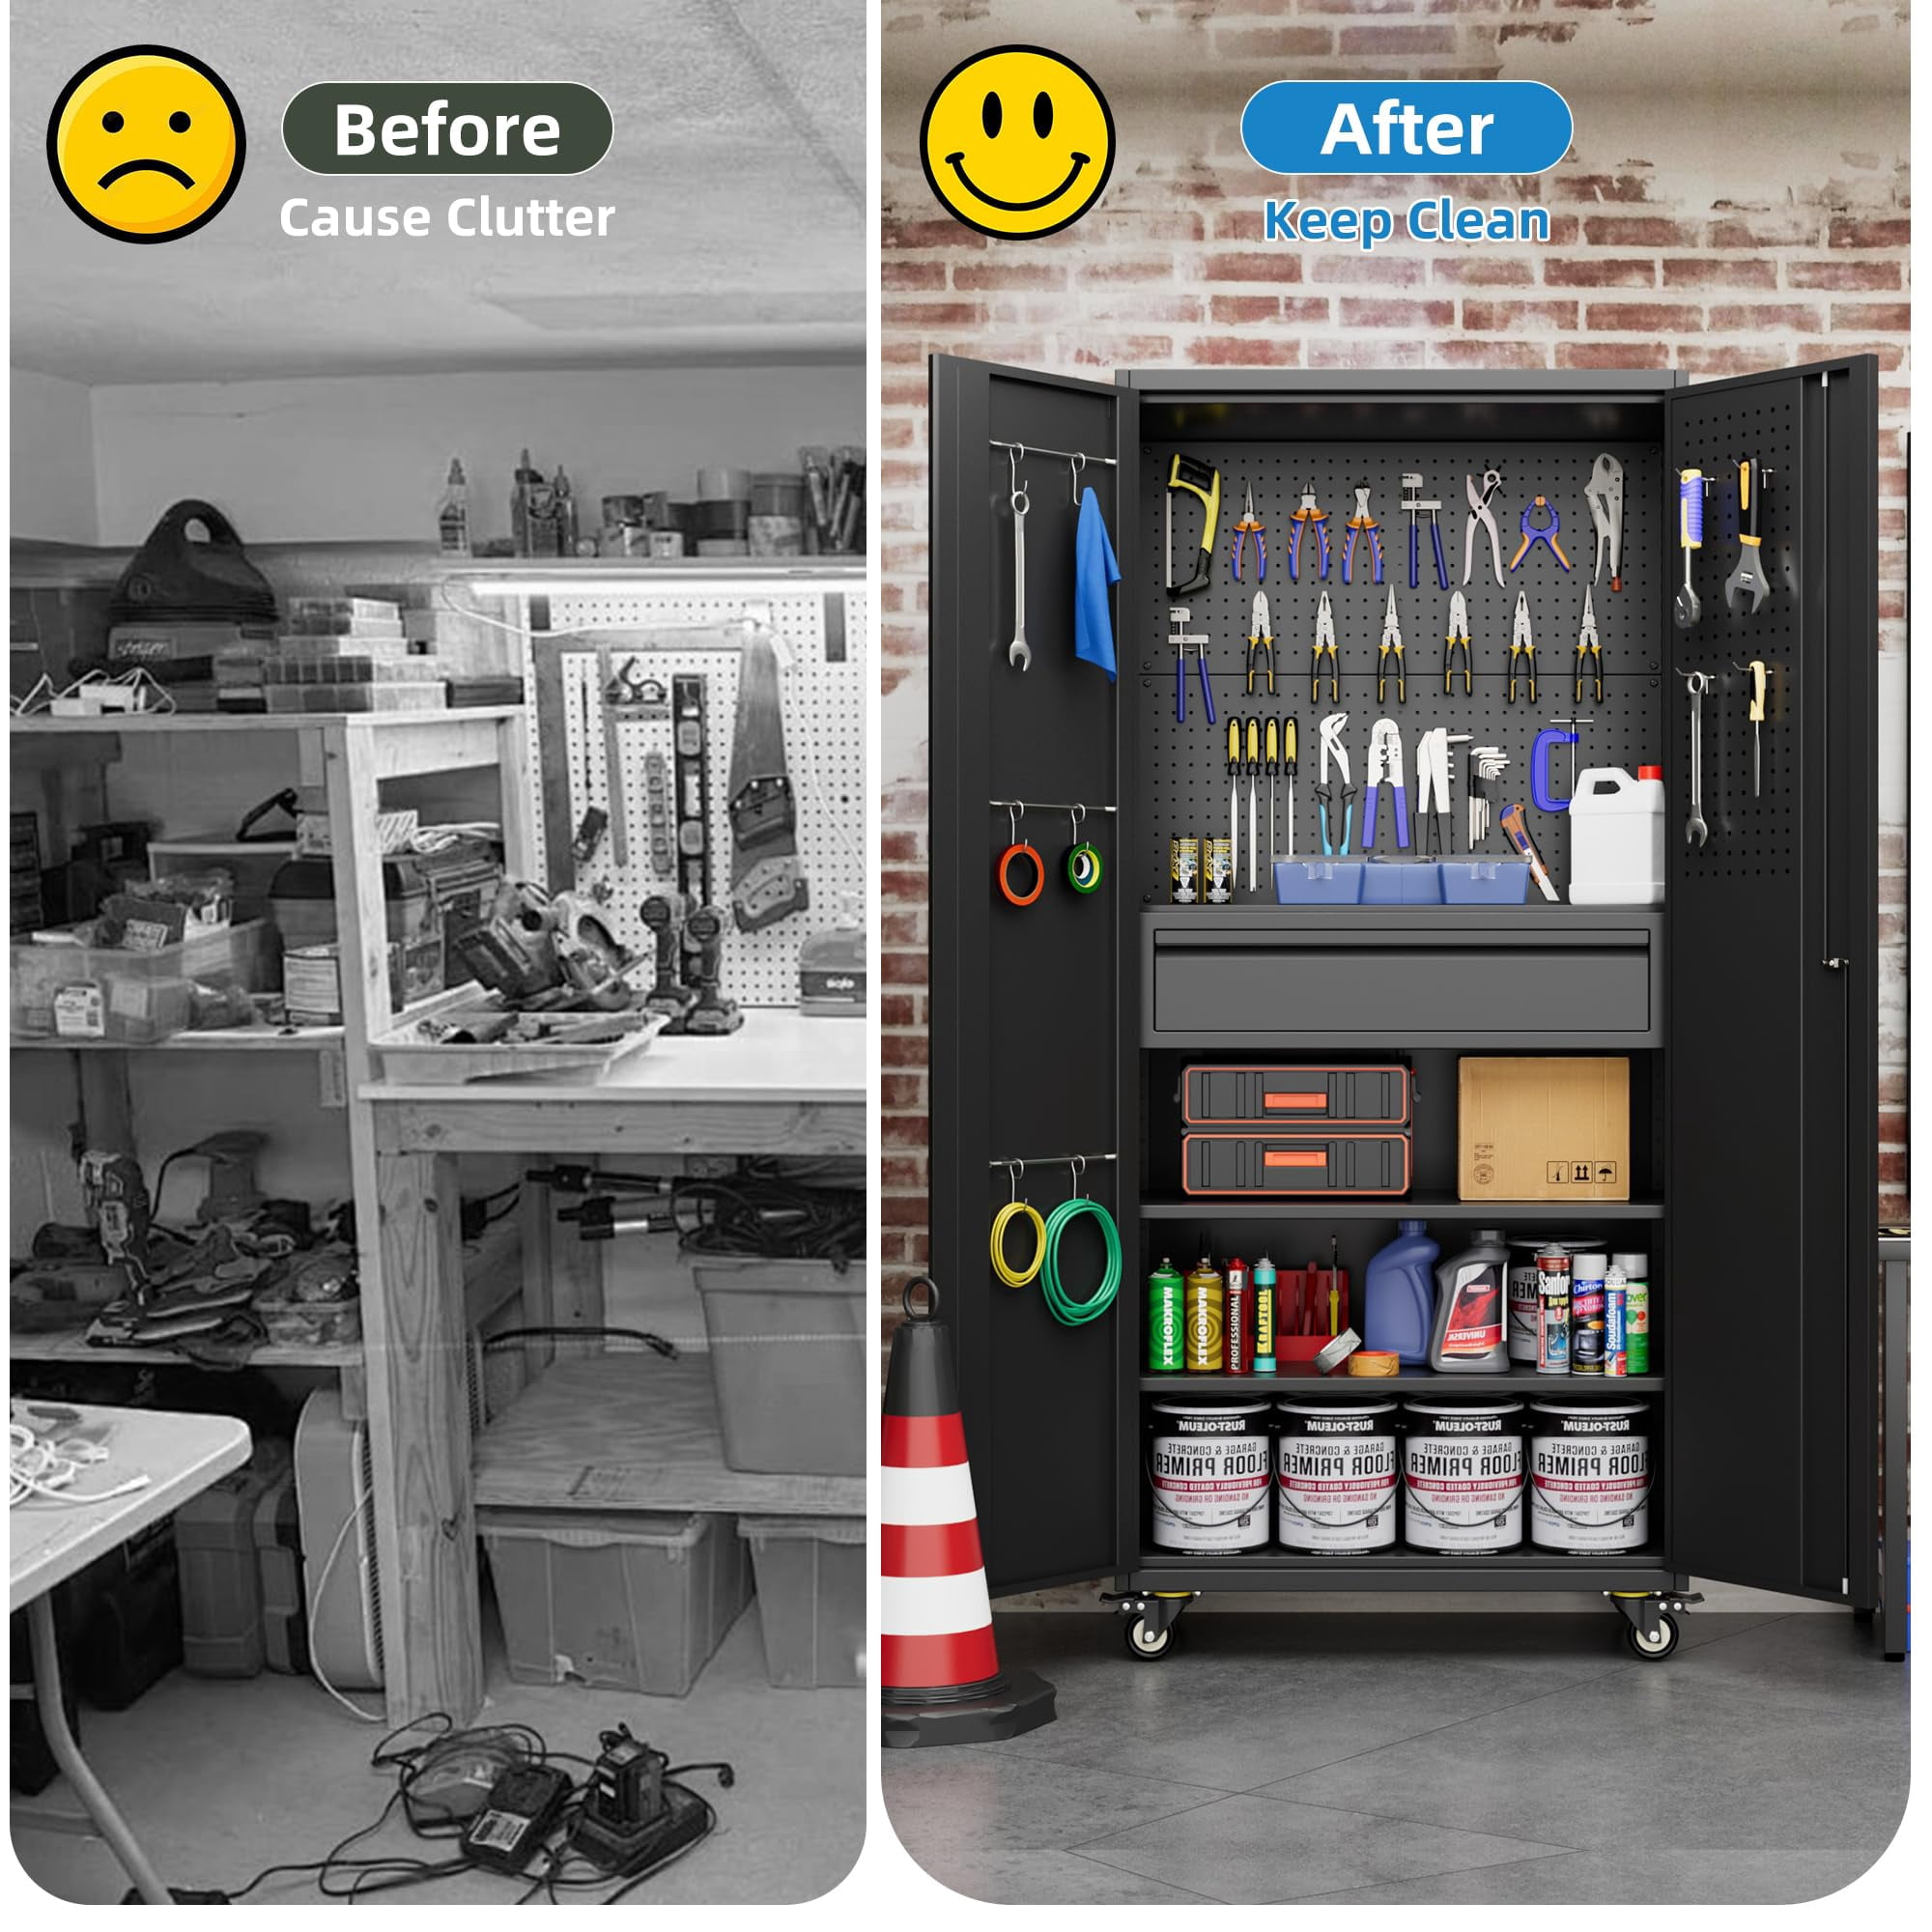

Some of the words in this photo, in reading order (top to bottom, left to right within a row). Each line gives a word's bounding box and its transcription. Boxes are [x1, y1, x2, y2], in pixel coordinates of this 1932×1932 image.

[1538, 1271, 1570, 1295] Sanfor
[1163, 1287, 1174, 1366] MAKROFLEX
[1198, 1287, 1208, 1366] MAKROFLEX
[1231, 1295, 1239, 1370] PROFESSIONAL
[1257, 1289, 1268, 1353] KRAFTOOL
[1606, 1293, 1617, 1350] Soudafoam
